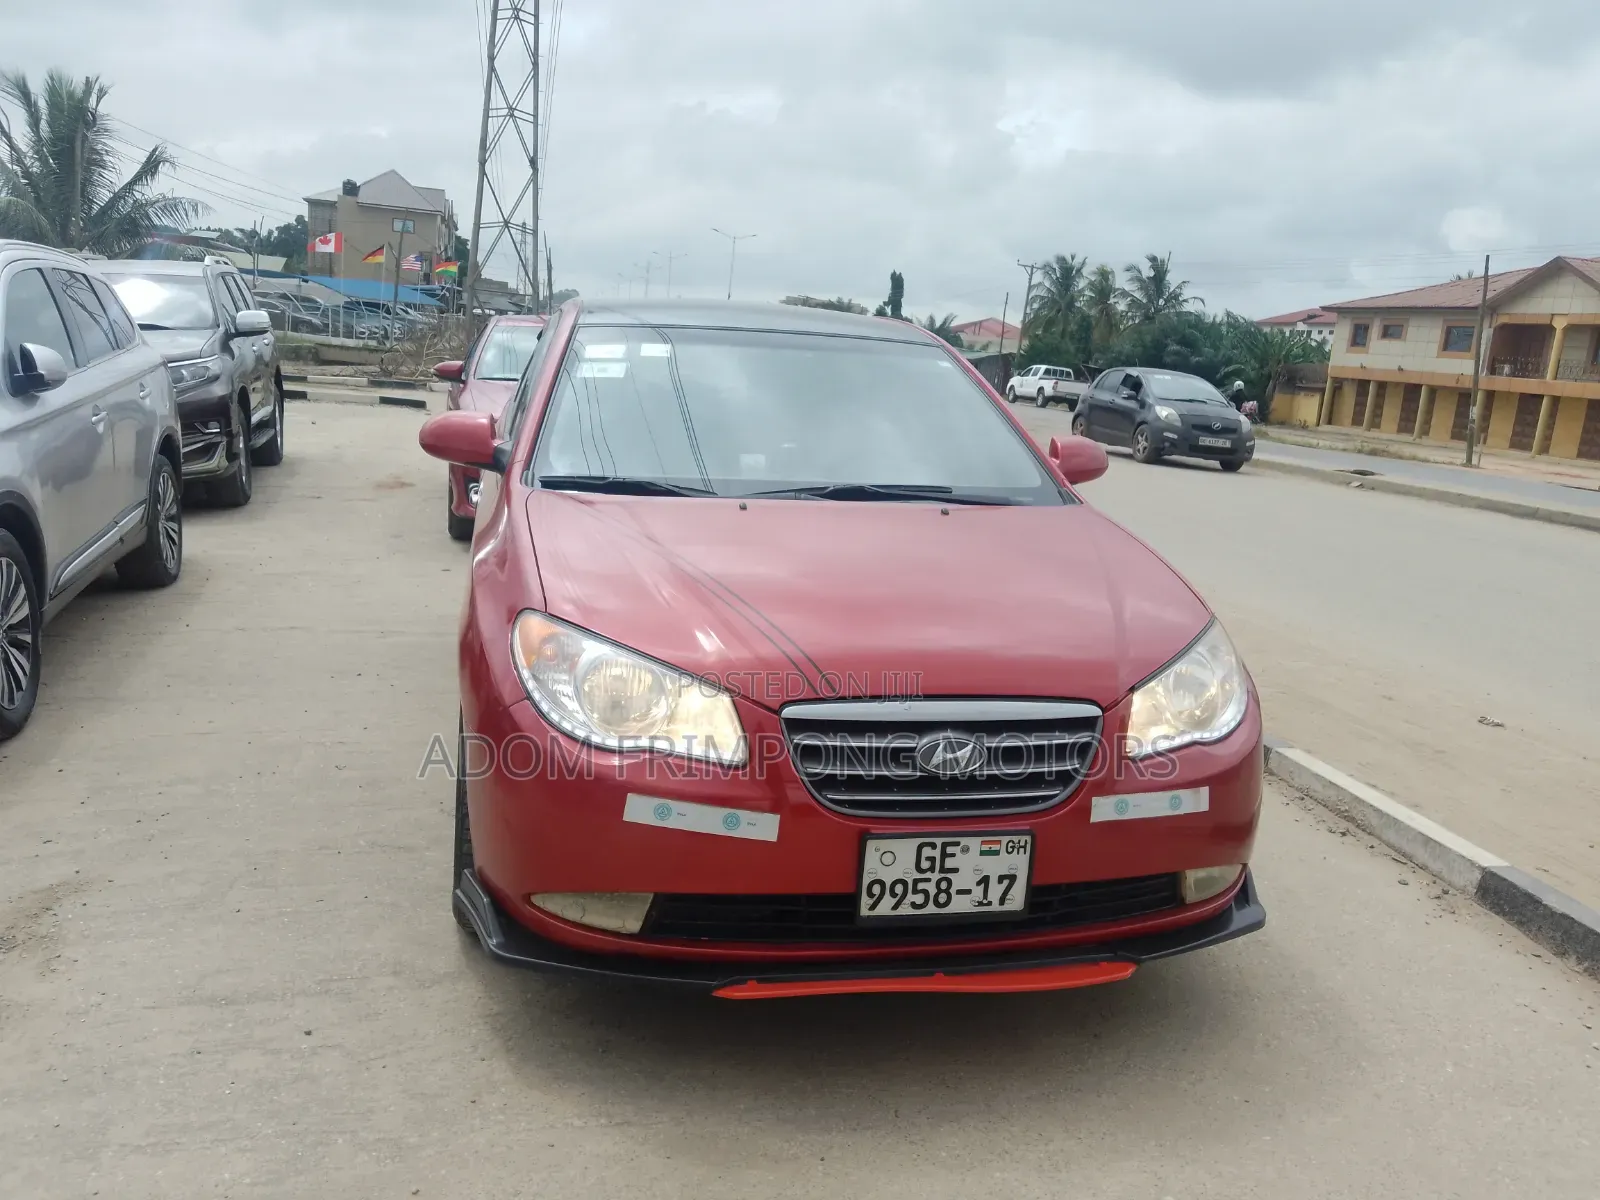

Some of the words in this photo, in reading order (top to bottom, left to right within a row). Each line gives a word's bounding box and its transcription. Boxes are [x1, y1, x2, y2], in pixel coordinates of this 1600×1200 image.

[914, 841, 961, 874] GE
[1005, 839, 1029, 855] GH
[866, 874, 1018, 912] 9958-17
